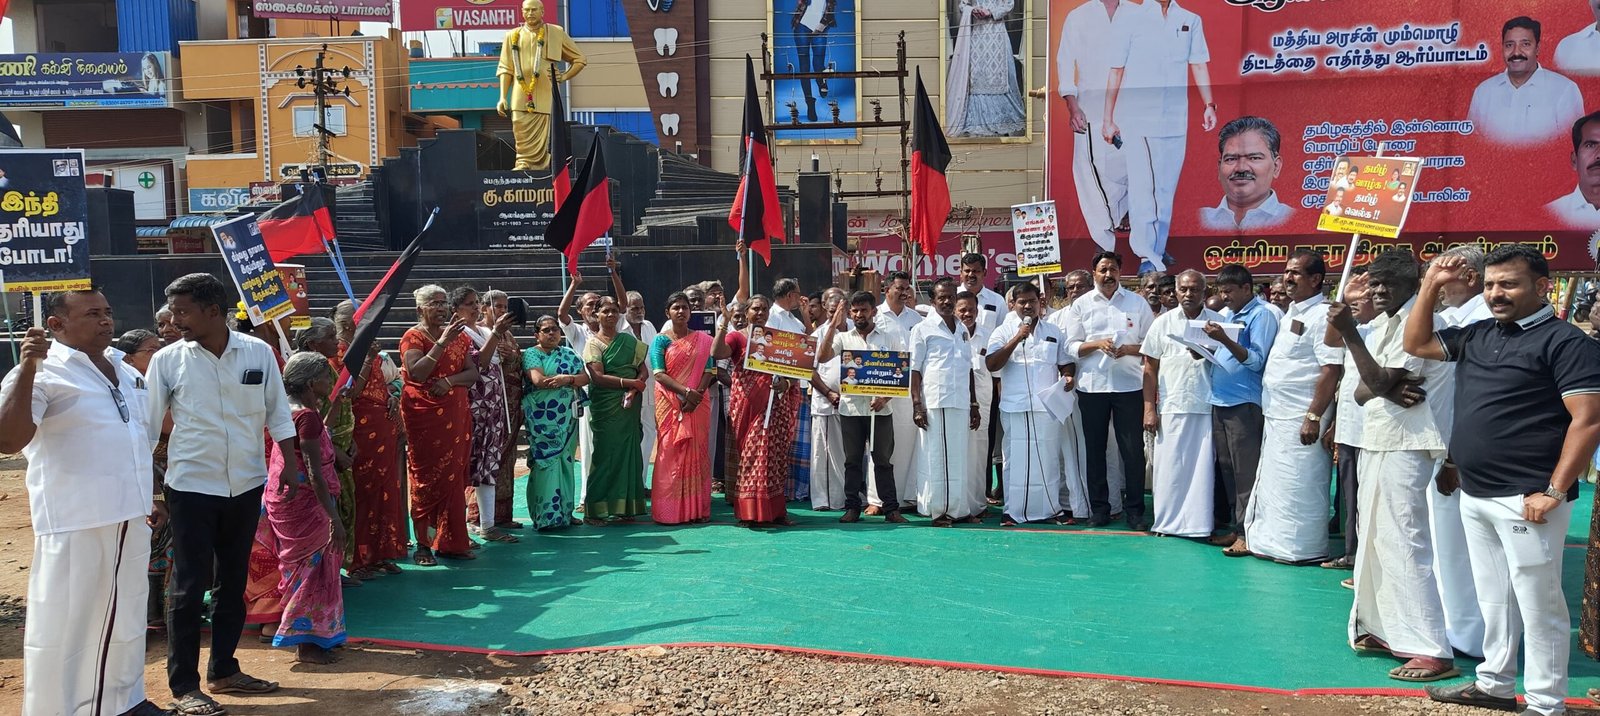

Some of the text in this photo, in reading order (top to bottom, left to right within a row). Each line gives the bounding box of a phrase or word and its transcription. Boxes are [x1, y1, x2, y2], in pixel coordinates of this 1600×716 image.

[454, 9, 515, 26] VASANTH
[1272, 22, 1460, 50] மத்திய அரசின் மும்மொழி
[40, 57, 73, 75] கல்வி
[76, 58, 128, 76] நிலையம்
[1241, 44, 1488, 74] திட்டத்தை எதிர்த்து ஆர்ப்பாட்டம்
[1303, 119, 1473, 140] தமிழகத்தில் இன்னொரு
[1303, 138, 1359, 155] மொழிப்
[1303, 156, 1335, 175] எதிர்
[1363, 164, 1388, 176] தமிழ்
[483, 175, 533, 186] பெருந்தலைவர்
[1302, 175, 1331, 191] இரு
[1, 190, 59, 217] இந்தி
[483, 188, 555, 207] கு.காமரா
[1301, 194, 1327, 209] முத
[1353, 193, 1378, 206] தமிழ்
[499, 210, 537, 219] ஆலங்குளம்
[0, 244, 74, 266] போடா!
[856, 249, 1017, 277] Wome's
[1204, 240, 1288, 269] ஒன்றிய
